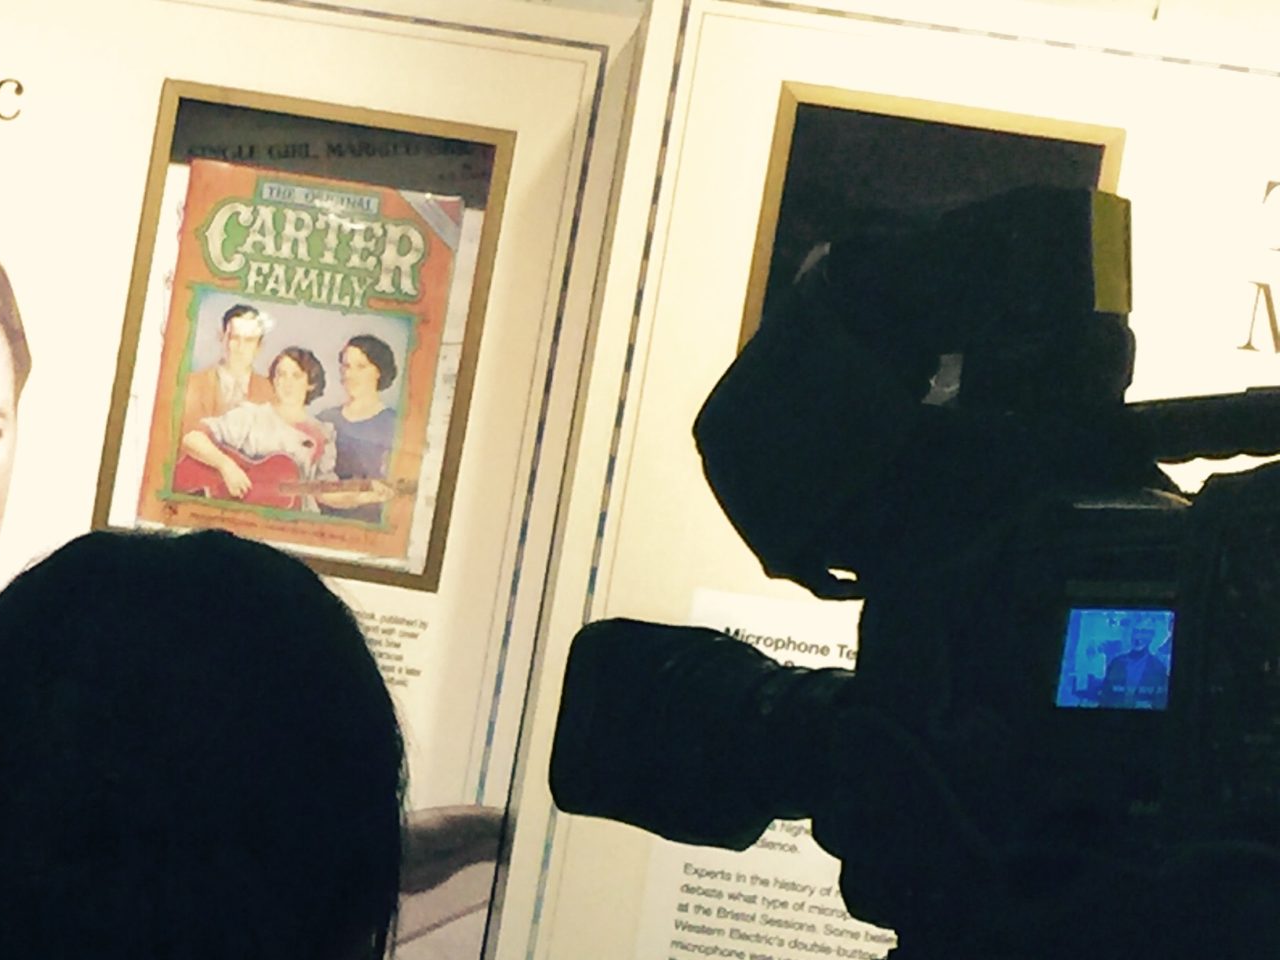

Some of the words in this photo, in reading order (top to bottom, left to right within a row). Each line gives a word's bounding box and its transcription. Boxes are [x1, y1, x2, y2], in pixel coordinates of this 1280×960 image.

[205, 202, 424, 296] CARTER
[245, 260, 373, 308] FAMILY
[724, 627, 830, 657] Microphone
